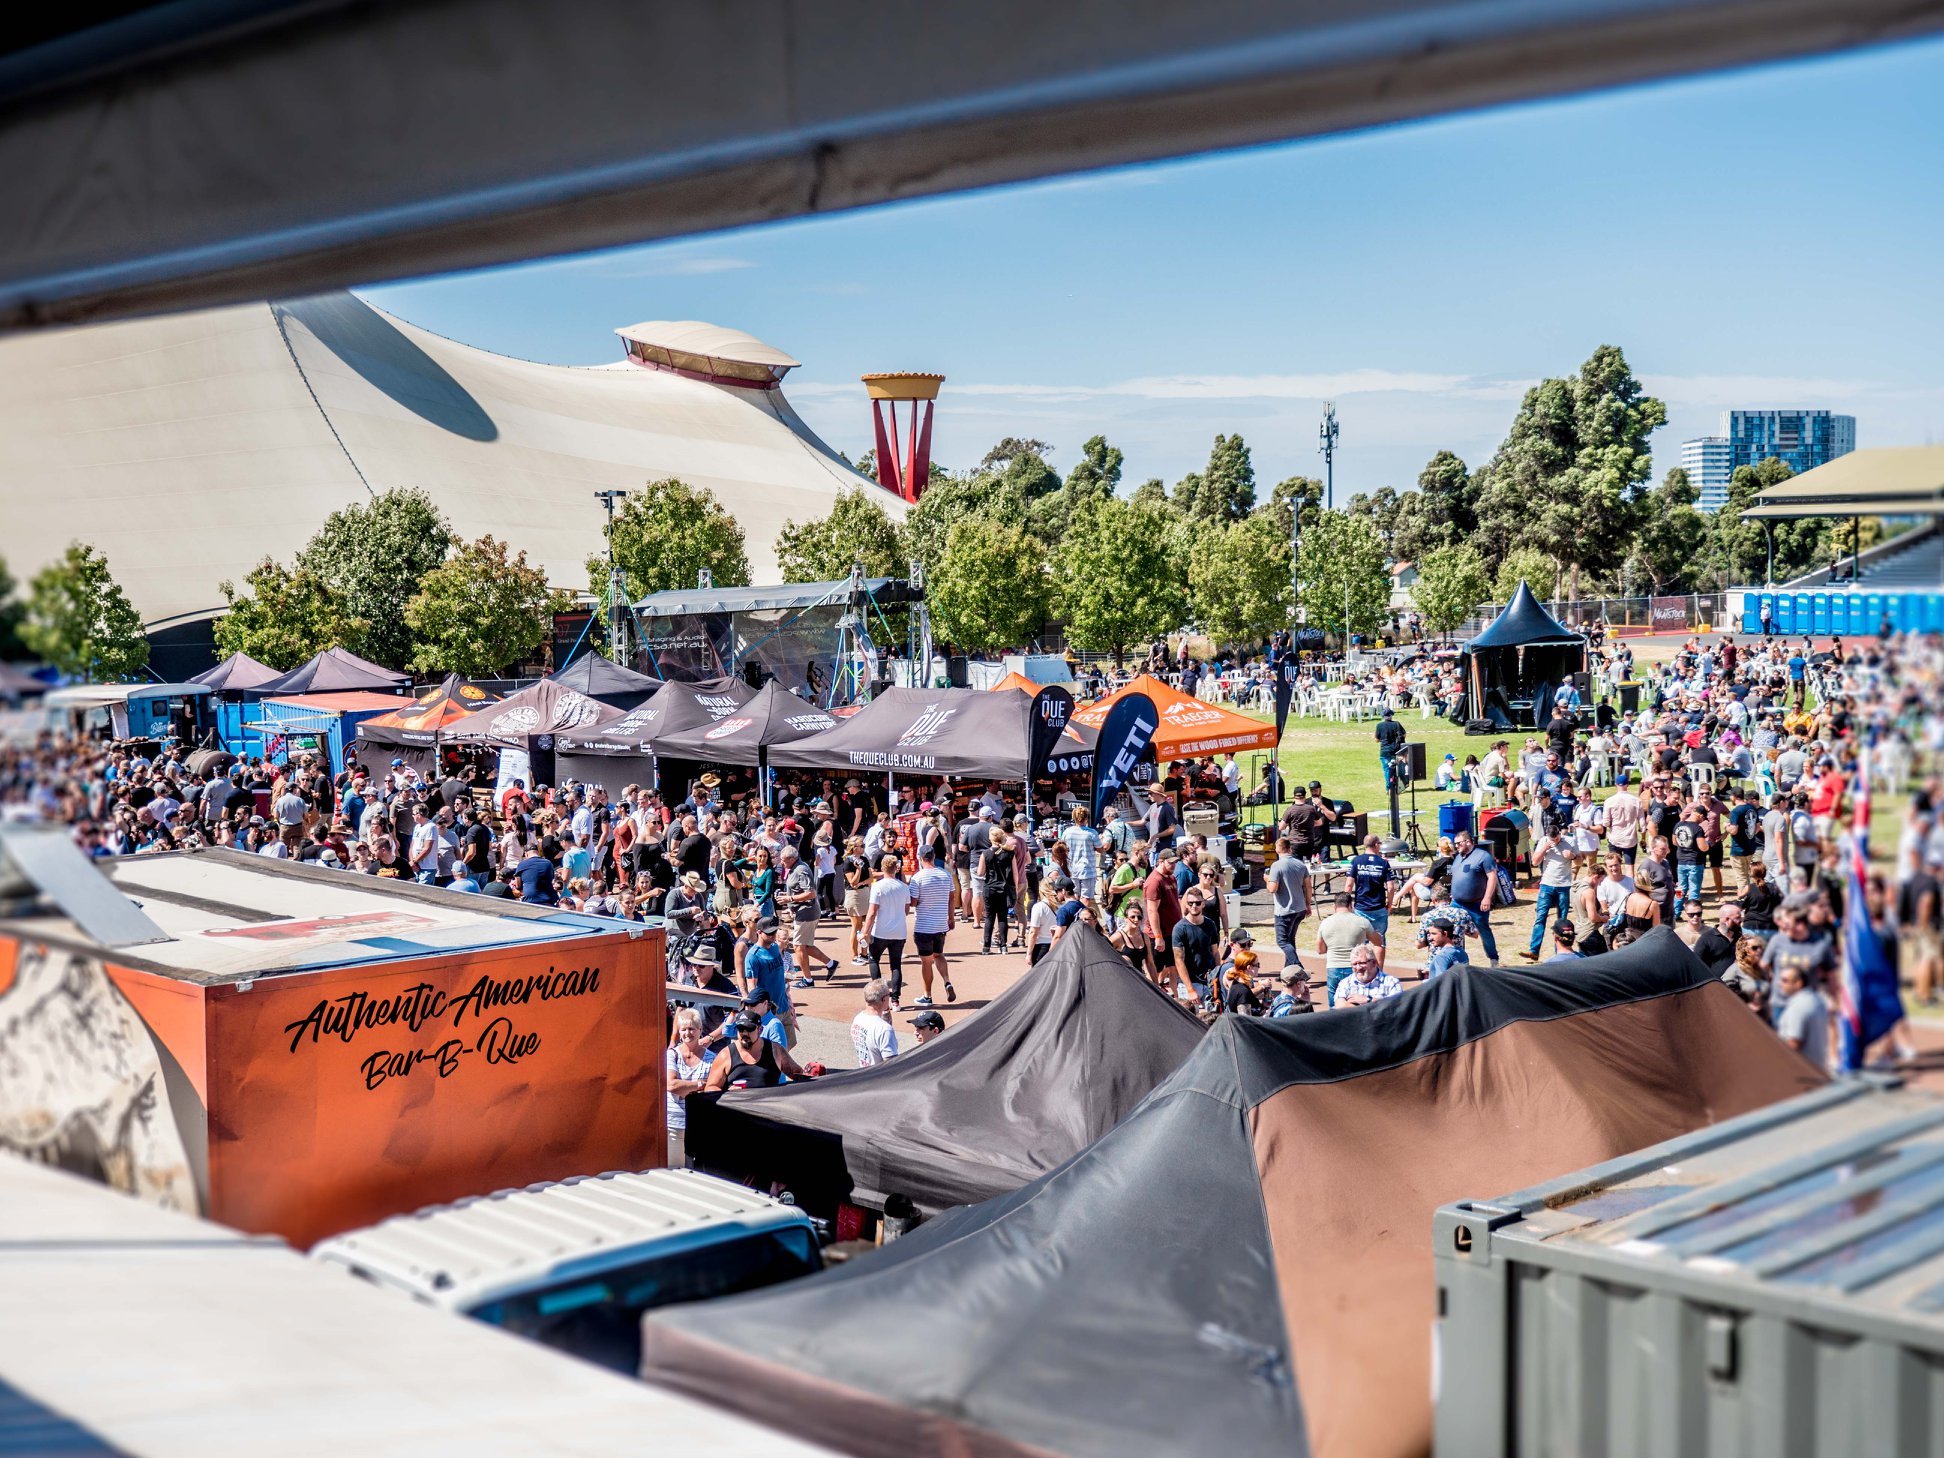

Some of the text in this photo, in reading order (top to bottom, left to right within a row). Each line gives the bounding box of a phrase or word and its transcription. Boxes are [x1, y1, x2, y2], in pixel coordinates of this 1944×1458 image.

[694, 694, 739, 707] NATURAL
[1042, 693, 1051, 701] THE
[1041, 700, 1066, 721] QUE
[1162, 710, 1225, 726] TRAEGER
[783, 714, 834, 725] HARDCORE
[791, 720, 837, 731] CARNIVORE
[899, 708, 957, 742] QUE
[1047, 718, 1065, 728] CLUB
[1199, 739, 1218, 751] WOOD
[1218, 736, 1237, 748] FIRED
[849, 750, 935, 770] THEQUECLUB.COM.AU
[1099, 716, 1154, 789] YETI
[284, 965, 600, 1053] Authentic American
[360, 1016, 541, 1091] Bar-B-Que
